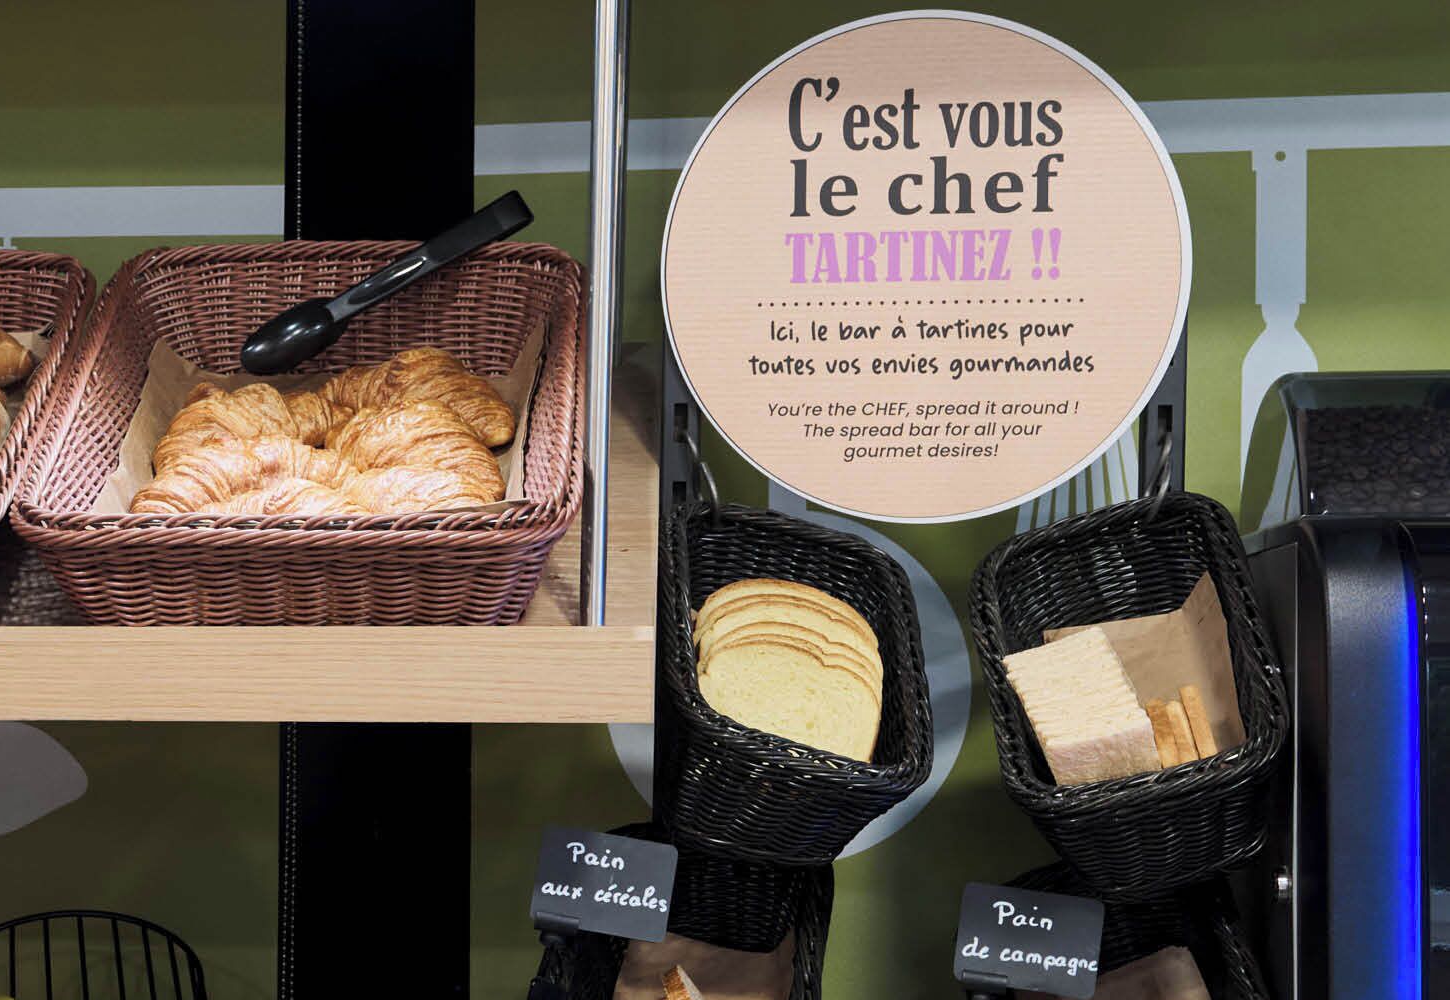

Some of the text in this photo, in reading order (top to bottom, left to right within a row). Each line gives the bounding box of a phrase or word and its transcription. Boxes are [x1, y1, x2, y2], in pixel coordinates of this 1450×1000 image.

[788, 77, 1063, 152] C'est vous
[790, 153, 1064, 217] le chef
[784, 229, 1012, 284] TARTINEZ
[769, 315, 1074, 347] Ici, le bar à tartines pour
[748, 350, 1095, 380] toutes vos envies gourmandes
[768, 402, 823, 417] You're
[827, 402, 857, 416] the
[861, 402, 911, 418] CHEF,
[915, 401, 981, 420] spread
[985, 401, 997, 415] it
[1001, 401, 1069, 415] around
[803, 422, 1043, 441] The spread bar for all your
[843, 443, 999, 463] gourmet desires!
[566, 842, 625, 870] Pain
[541, 881, 668, 913] aux céréales
[992, 901, 1053, 931] Pain
[961, 936, 1098, 976] de campagne
